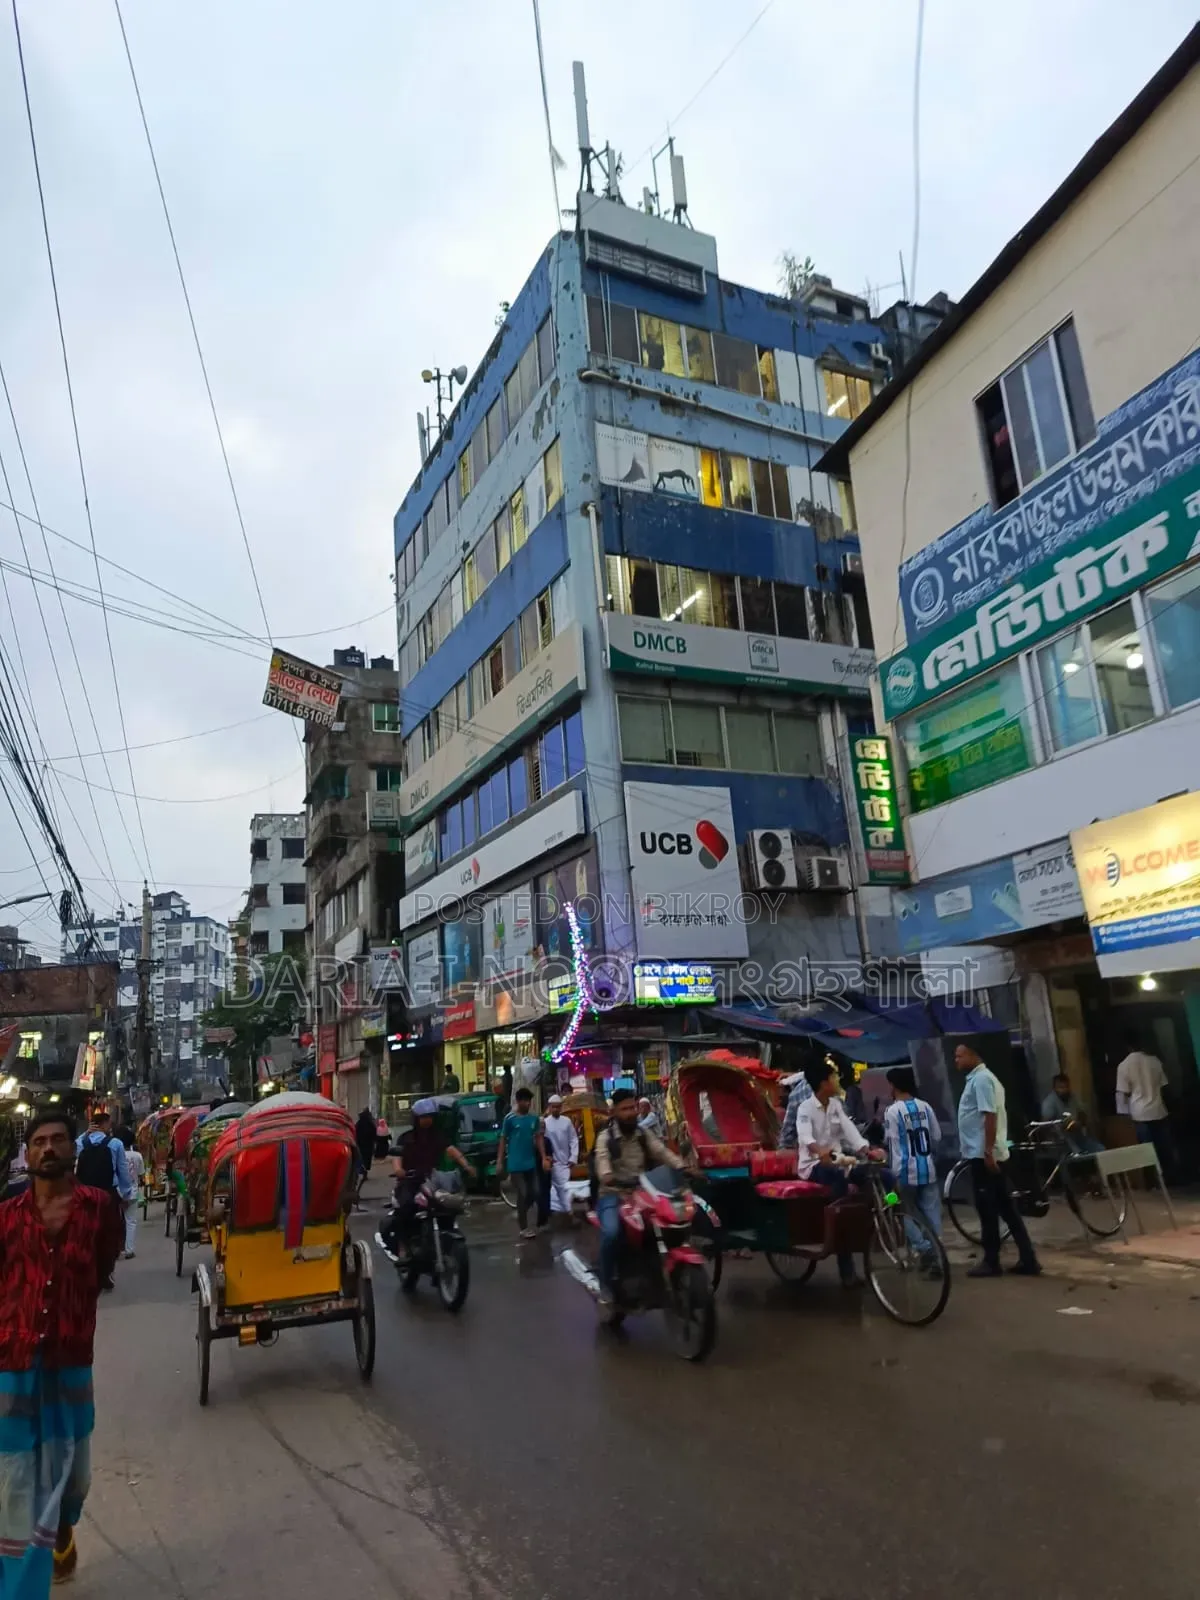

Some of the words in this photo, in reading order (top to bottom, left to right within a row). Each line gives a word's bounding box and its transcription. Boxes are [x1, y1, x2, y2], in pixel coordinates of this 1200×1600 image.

[922, 510, 1169, 690] মেডিটেক
[633, 630, 687, 654] DMCB
[268, 670, 305, 694] হাতের
[307, 683, 338, 707] লেখা
[410, 780, 429, 809] DMCB
[640, 831, 693, 855] UCB
[460, 867, 473, 886] UCB
[1086, 838, 1200, 888] WELCOME
[906, 1127, 931, 1157] 10
